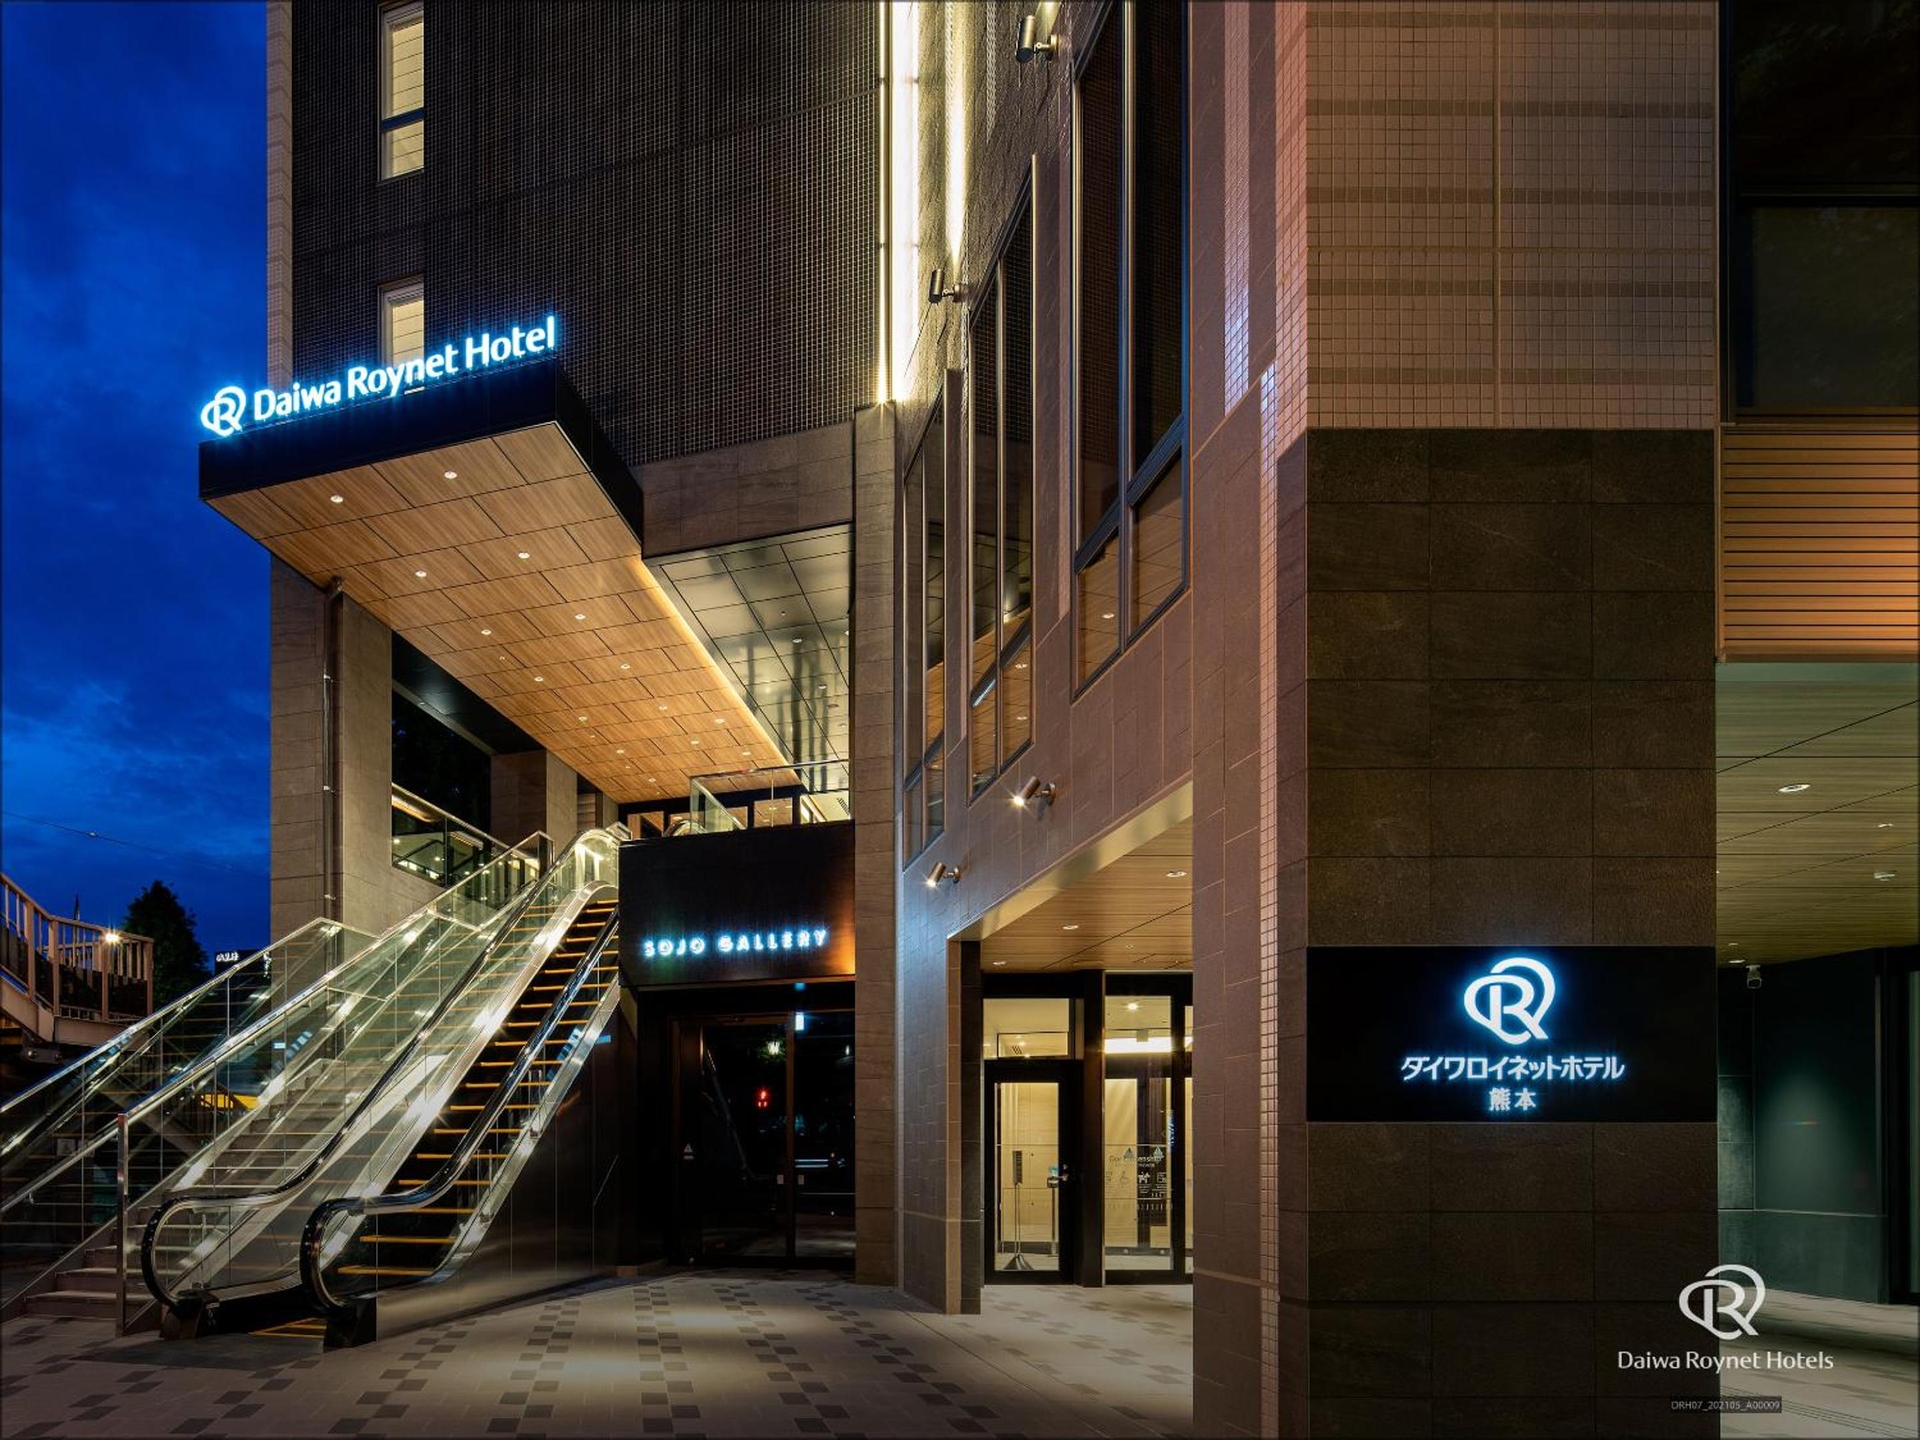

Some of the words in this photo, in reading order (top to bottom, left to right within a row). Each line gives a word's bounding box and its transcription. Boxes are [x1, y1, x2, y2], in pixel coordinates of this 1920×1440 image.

[253, 379, 342, 421] Daiwa
[348, 344, 459, 396] Roynet
[466, 316, 556, 368] Hotel
[644, 937, 706, 957] SOJO
[717, 929, 827, 952] GALLERY
[1401, 1055, 1625, 1081] ダイワロイネットホテル
[1488, 1087, 1537, 1111] 熊本
